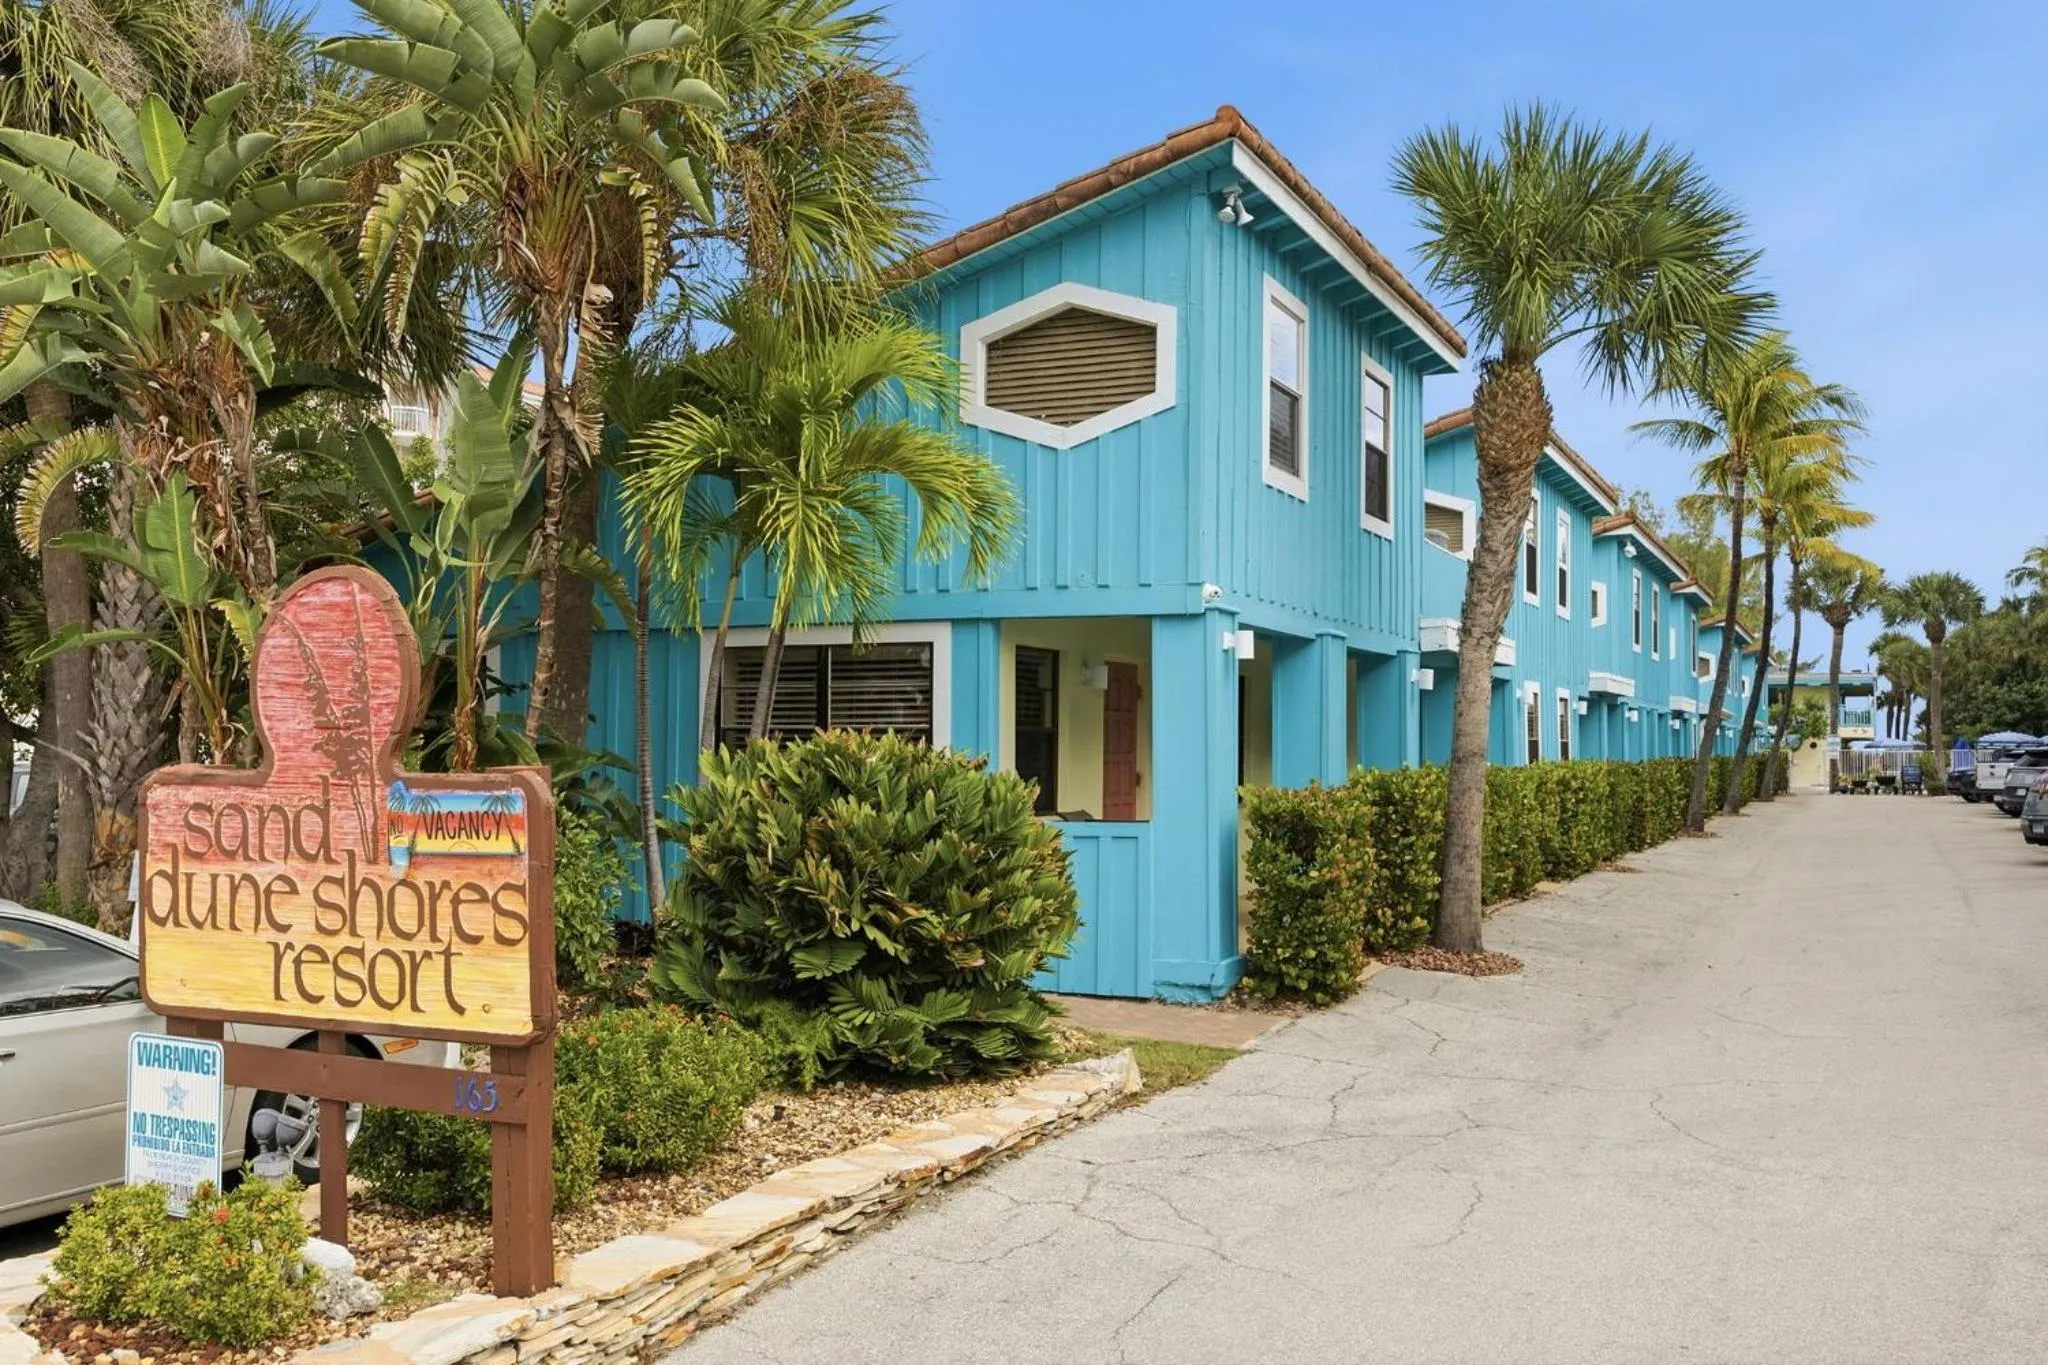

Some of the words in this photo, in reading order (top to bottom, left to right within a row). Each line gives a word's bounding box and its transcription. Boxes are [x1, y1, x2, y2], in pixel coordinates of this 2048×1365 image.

[185, 775, 346, 864] sand
[390, 814, 404, 836] NO
[422, 810, 503, 841] VACANCY
[147, 843, 299, 934] dune
[314, 849, 529, 946] shores
[268, 927, 466, 1016] resort
[137, 1041, 216, 1076] WARNING!
[455, 1072, 498, 1112] 165
[133, 1111, 146, 1135] NO
[150, 1114, 215, 1146] TRESPASSING
[172, 1140, 180, 1154] LA
[183, 1142, 215, 1159] ENTRADA
